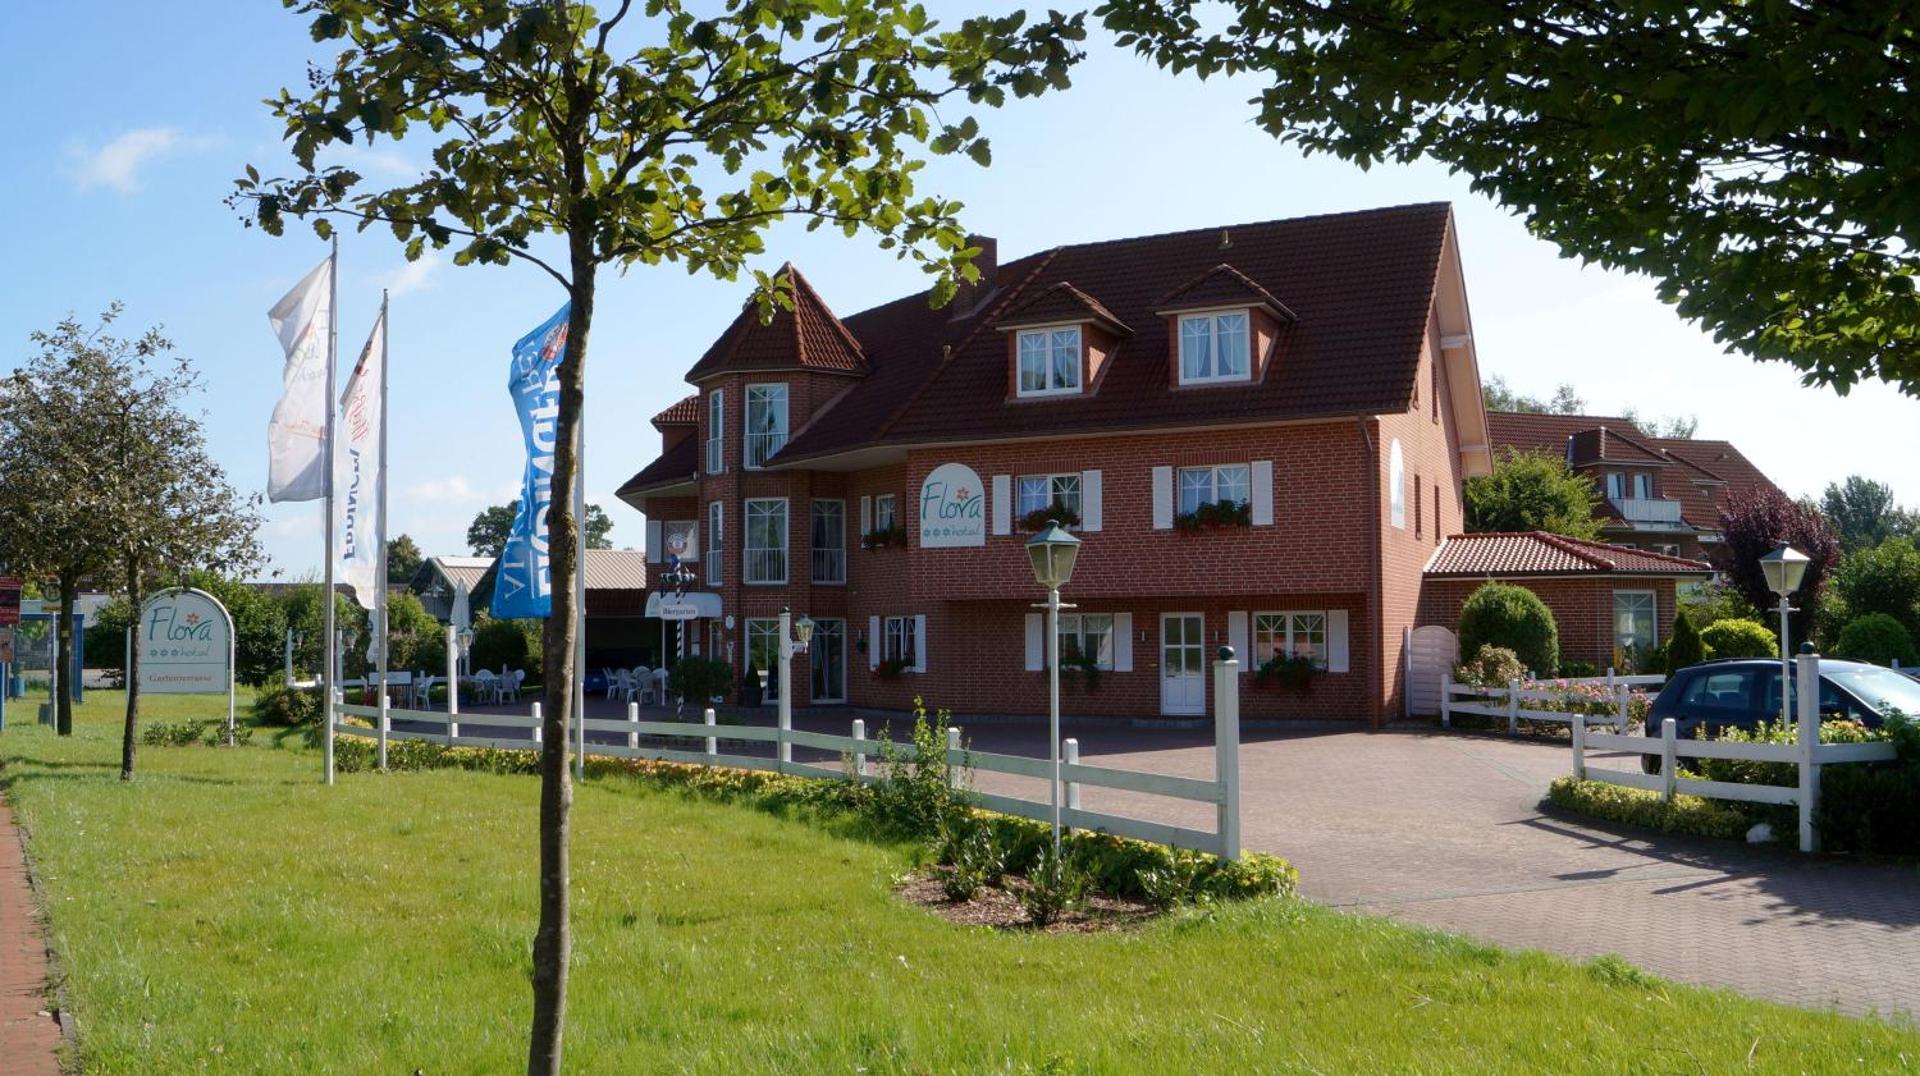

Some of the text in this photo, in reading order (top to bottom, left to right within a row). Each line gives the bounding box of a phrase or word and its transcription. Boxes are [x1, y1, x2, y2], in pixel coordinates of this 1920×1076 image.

[922, 481, 982, 519] Flora
[149, 606, 214, 641] Flora
[662, 606, 696, 617] Biergarten
